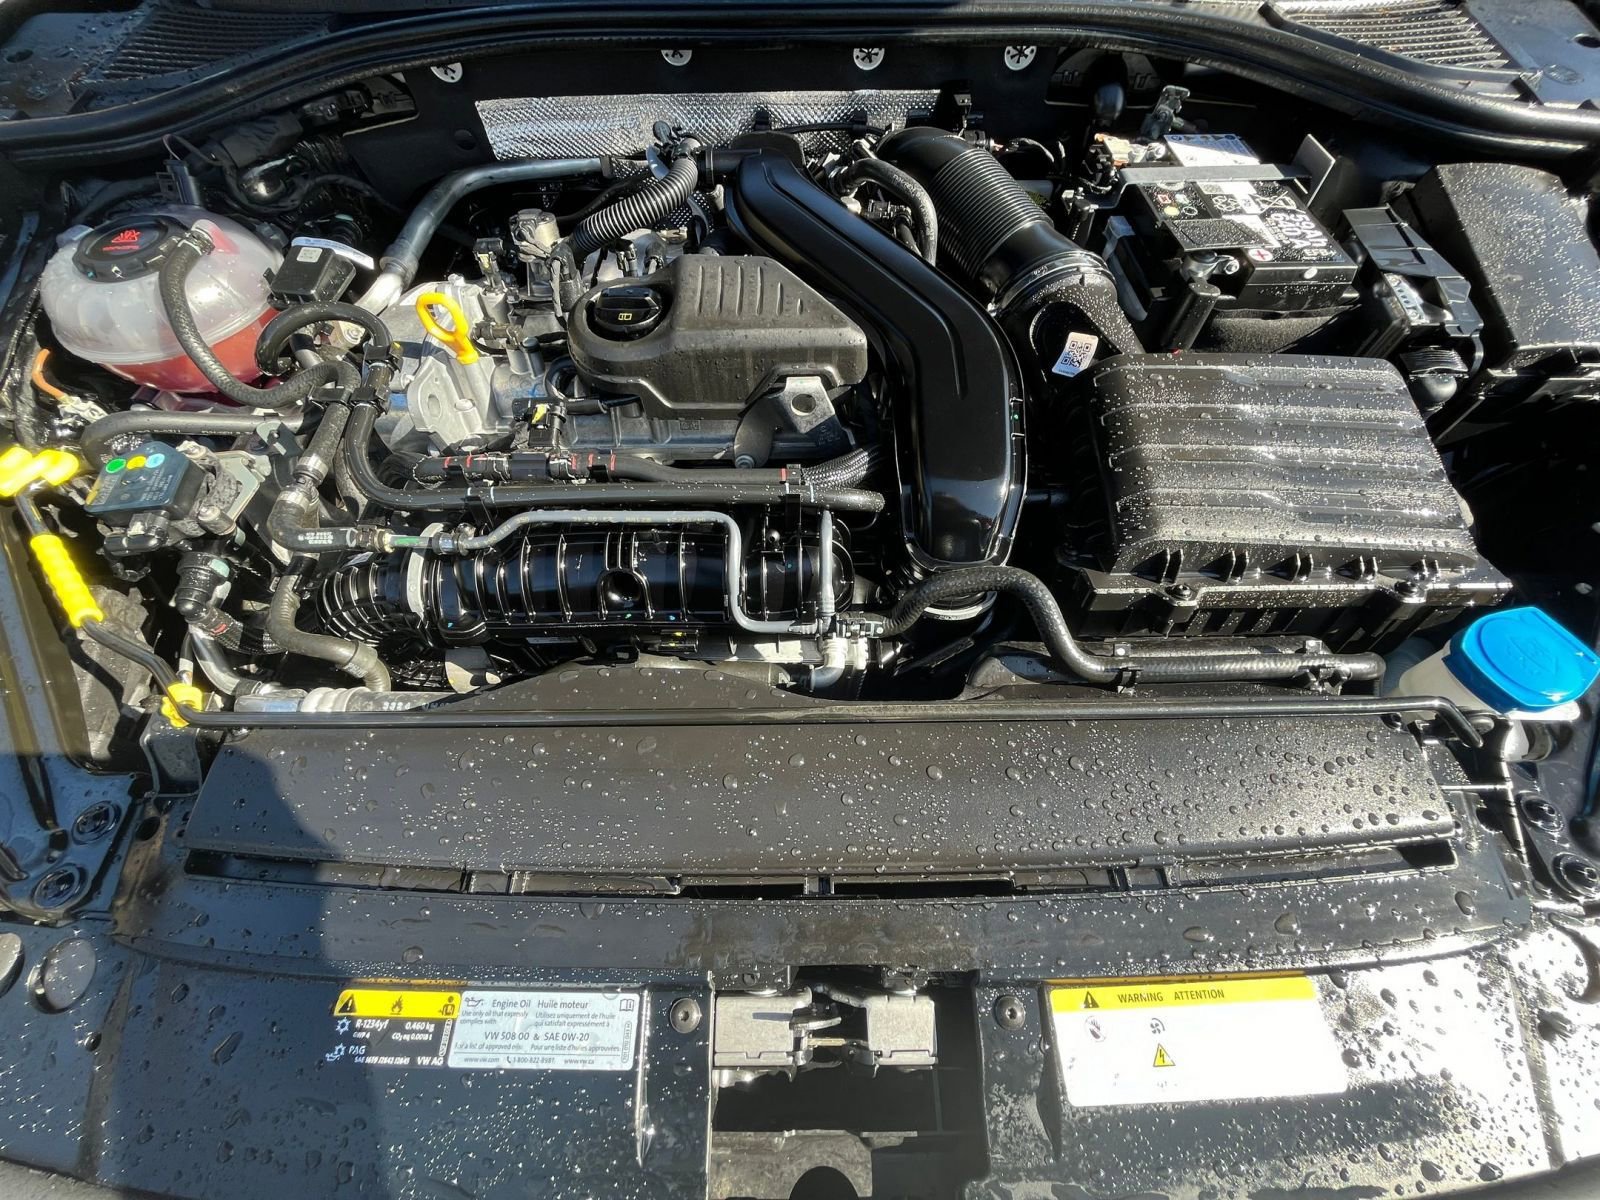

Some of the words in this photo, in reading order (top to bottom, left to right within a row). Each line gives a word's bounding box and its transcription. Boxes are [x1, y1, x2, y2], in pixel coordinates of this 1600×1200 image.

[1117, 992, 1164, 1004] WARNING
[1174, 989, 1225, 1000] ATTENTION
[492, 1000, 518, 1010] Engine
[520, 1000, 531, 1008] Oil
[538, 1000, 558, 1008] Huile
[356, 1019, 390, 1031] R-1234yf
[405, 1022, 426, 1030] 0.460
[426, 1022, 435, 1032] kg
[484, 1032, 499, 1040] VW
[501, 1032, 516, 1040] 508
[518, 1032, 530, 1040] 00
[544, 1032, 560, 1040] SAE
[562, 1033, 590, 1041] 0W-20
[348, 1045, 366, 1054] PAG
[417, 1056, 431, 1065] VW
[431, 1057, 444, 1066] AG
